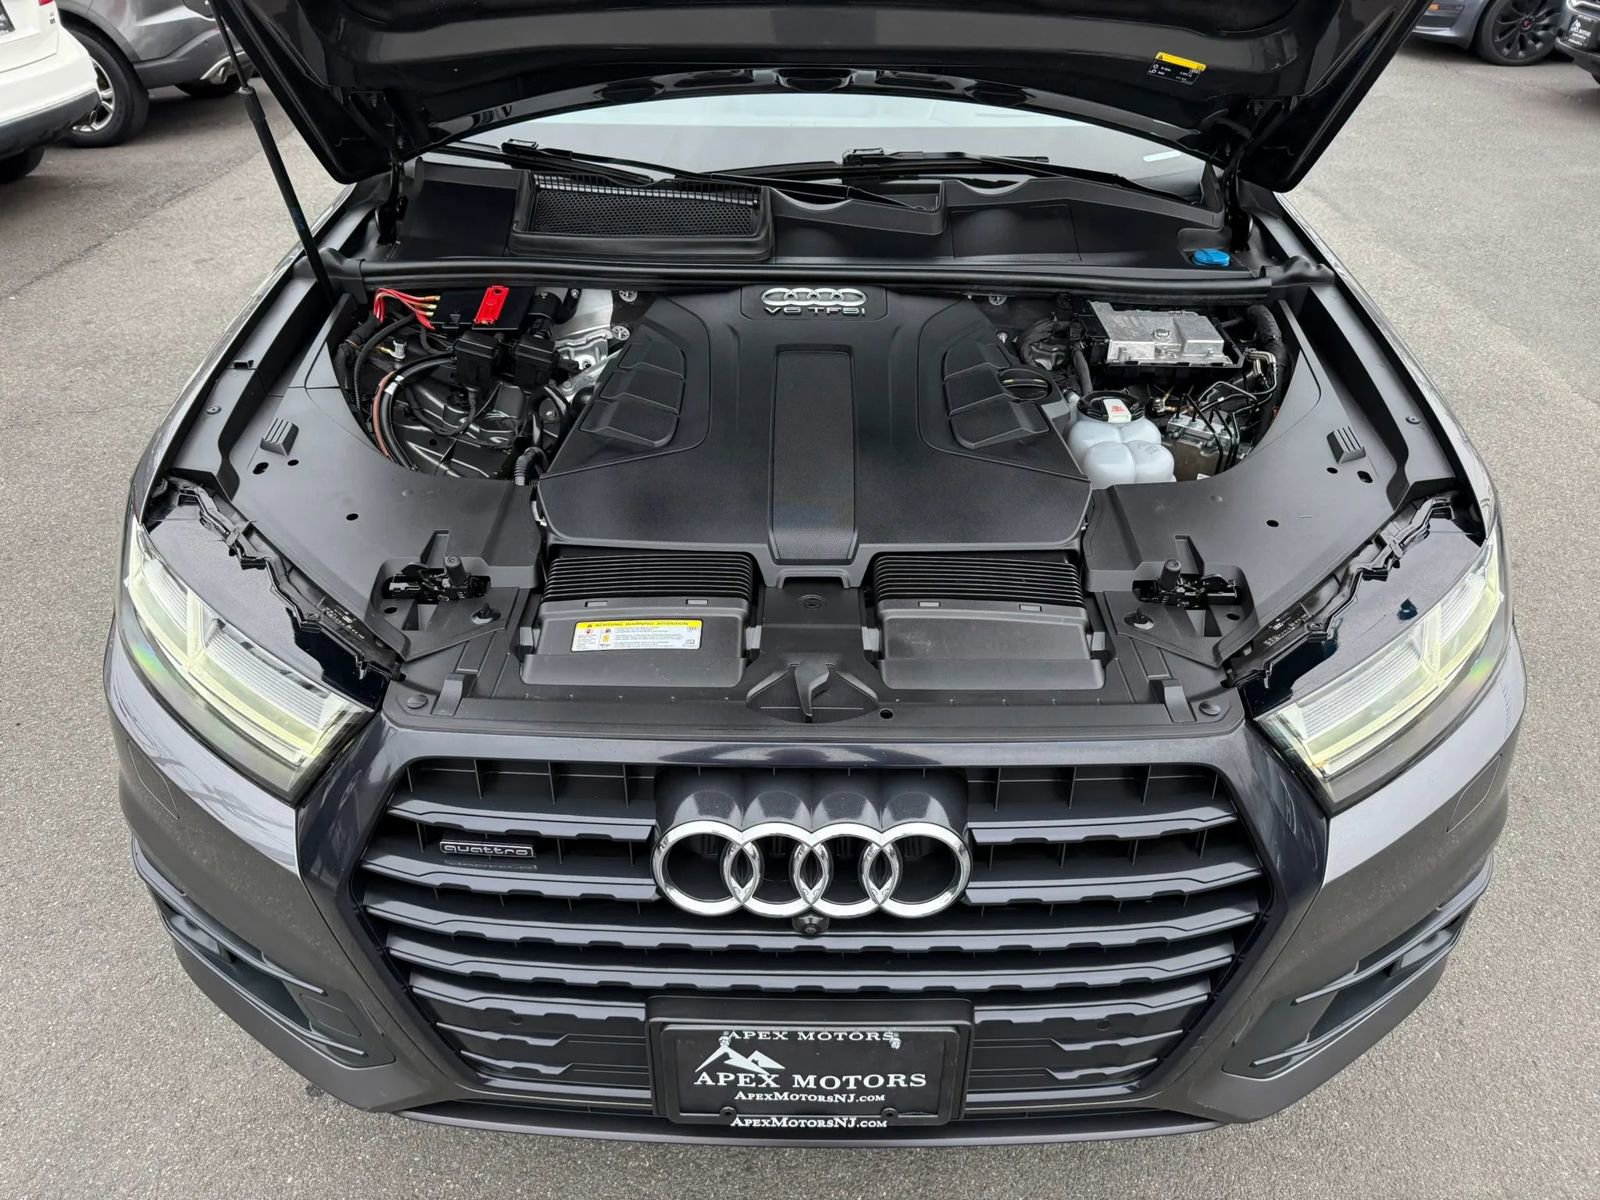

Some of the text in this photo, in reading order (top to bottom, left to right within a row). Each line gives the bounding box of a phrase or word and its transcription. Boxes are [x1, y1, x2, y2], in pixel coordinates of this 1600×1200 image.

[444, 845, 528, 855] quattro
[730, 1031, 894, 1042] APEX MOTORS
[694, 1071, 927, 1090] APEX MOTORS
